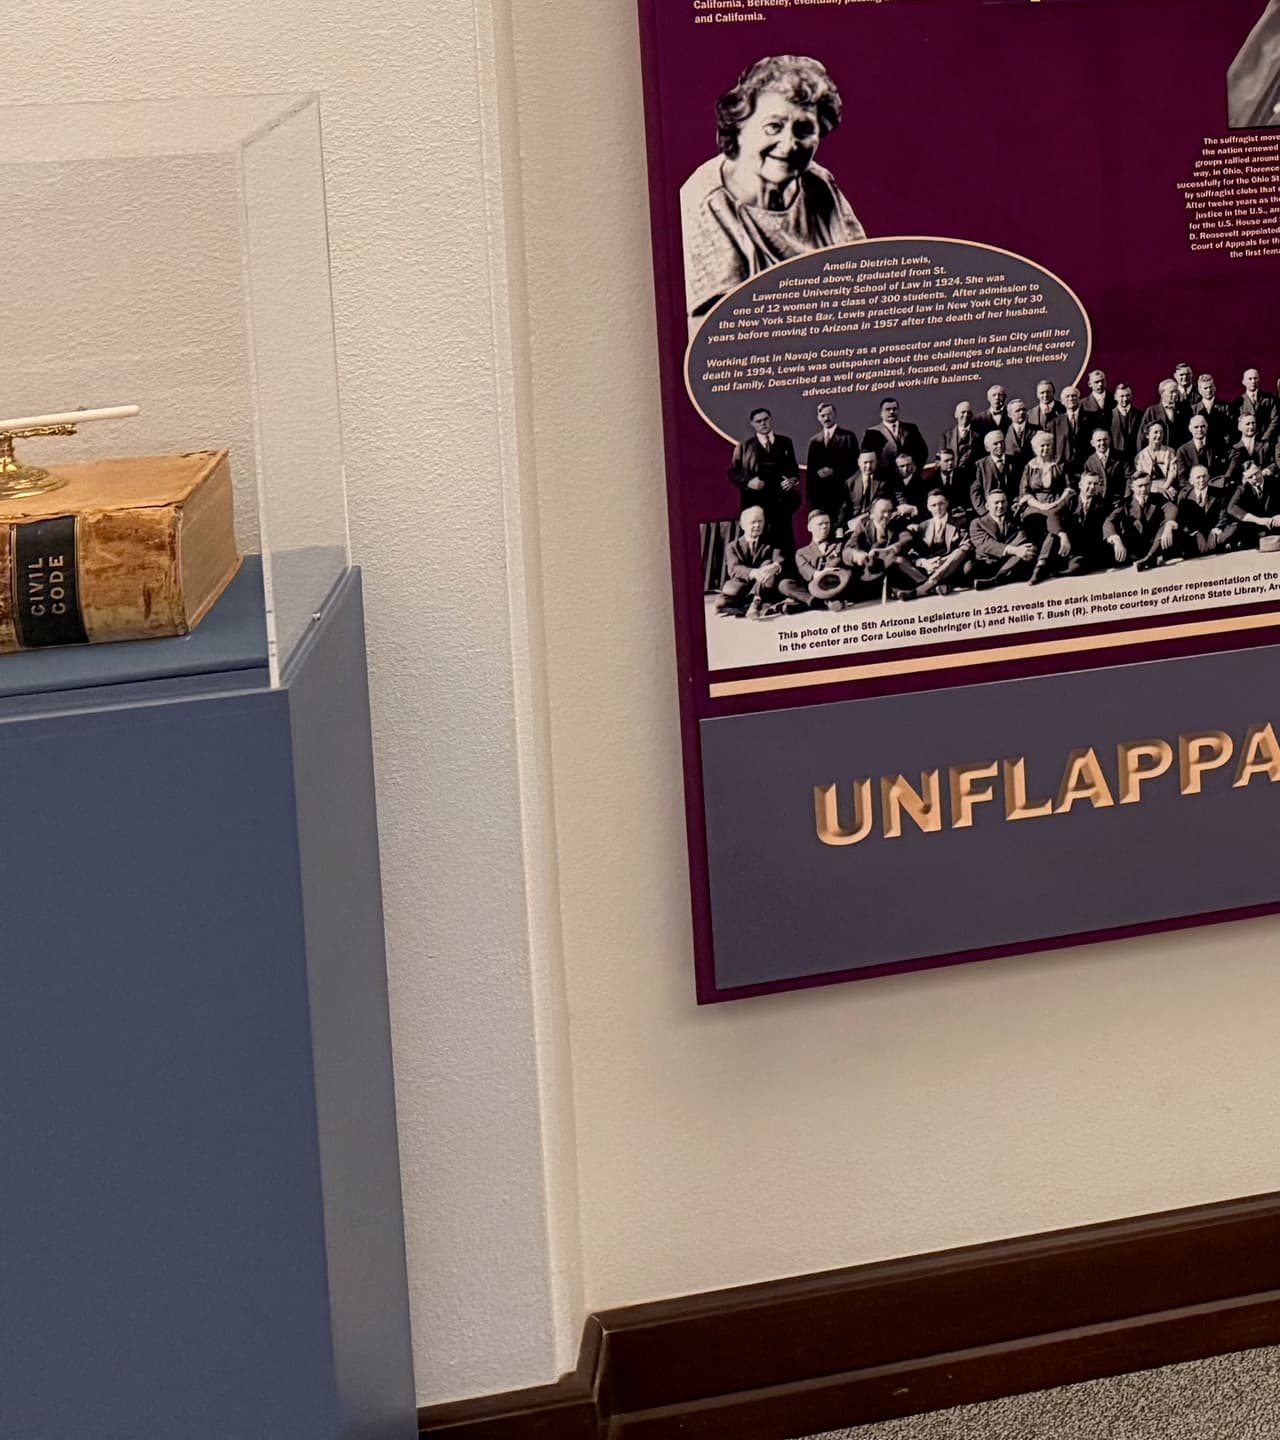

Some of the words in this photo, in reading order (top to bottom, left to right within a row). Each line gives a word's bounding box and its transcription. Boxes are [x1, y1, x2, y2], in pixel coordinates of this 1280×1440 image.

[823, 260, 857, 271] Amelia
[859, 257, 898, 268] Dietrich
[901, 255, 931, 265] Lewis,
[28, 557, 45, 617] CIVIL
[49, 554, 66, 615] CODE
